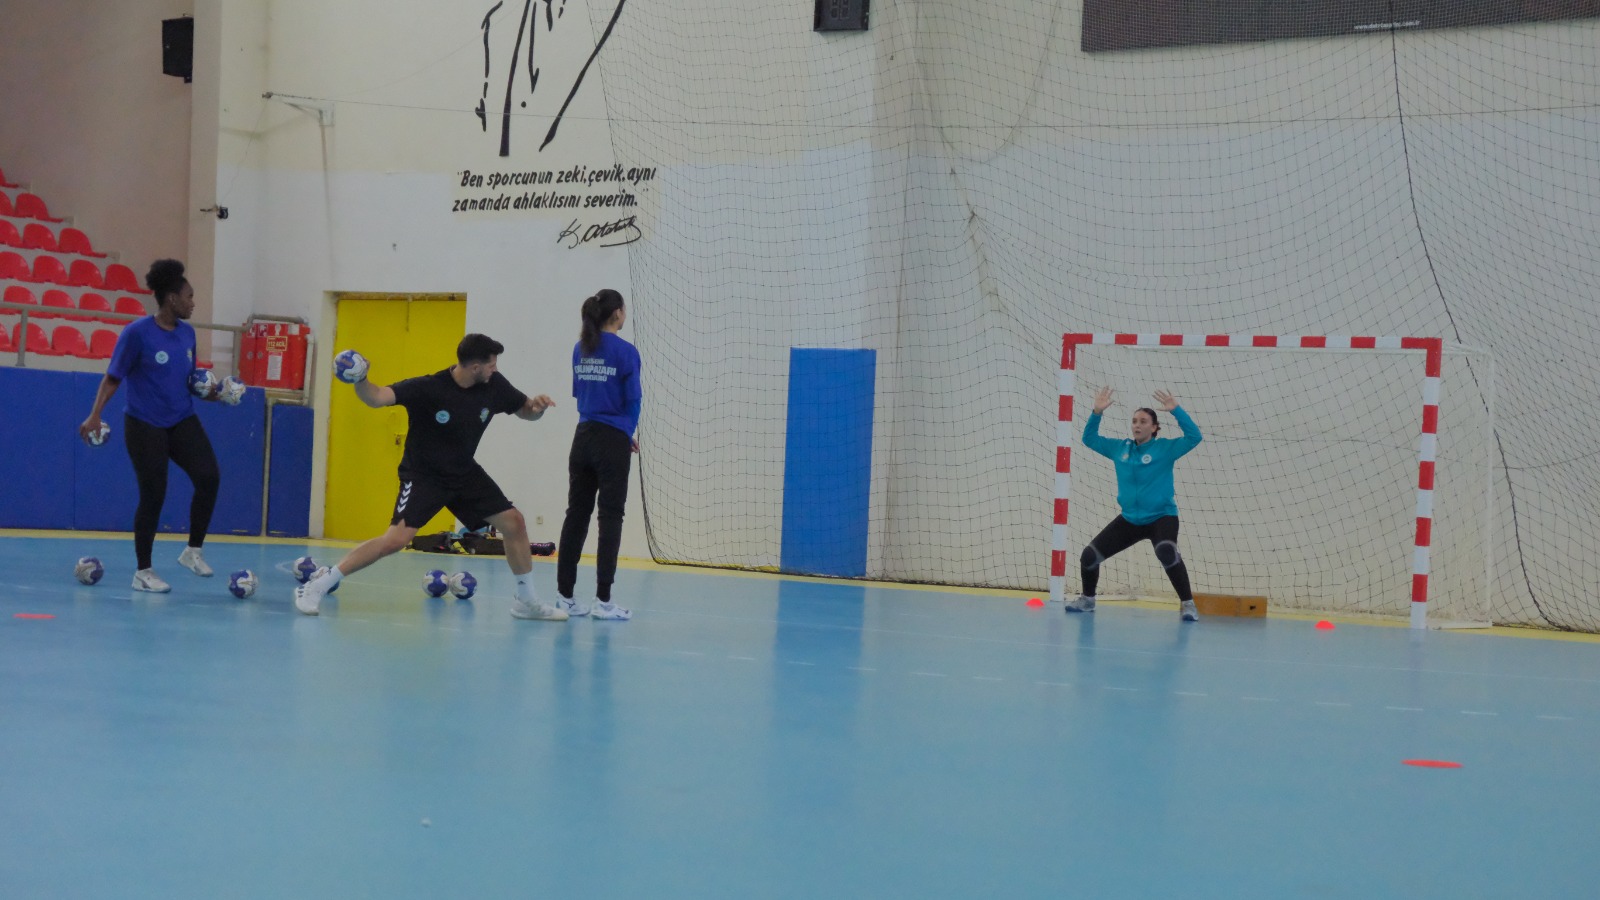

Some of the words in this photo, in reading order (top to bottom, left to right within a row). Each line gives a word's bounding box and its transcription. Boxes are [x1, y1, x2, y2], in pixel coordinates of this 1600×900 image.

[487, 171, 553, 190] sporcunun
[452, 193, 511, 212] zamanda
[513, 191, 581, 210] ahlaklısını
